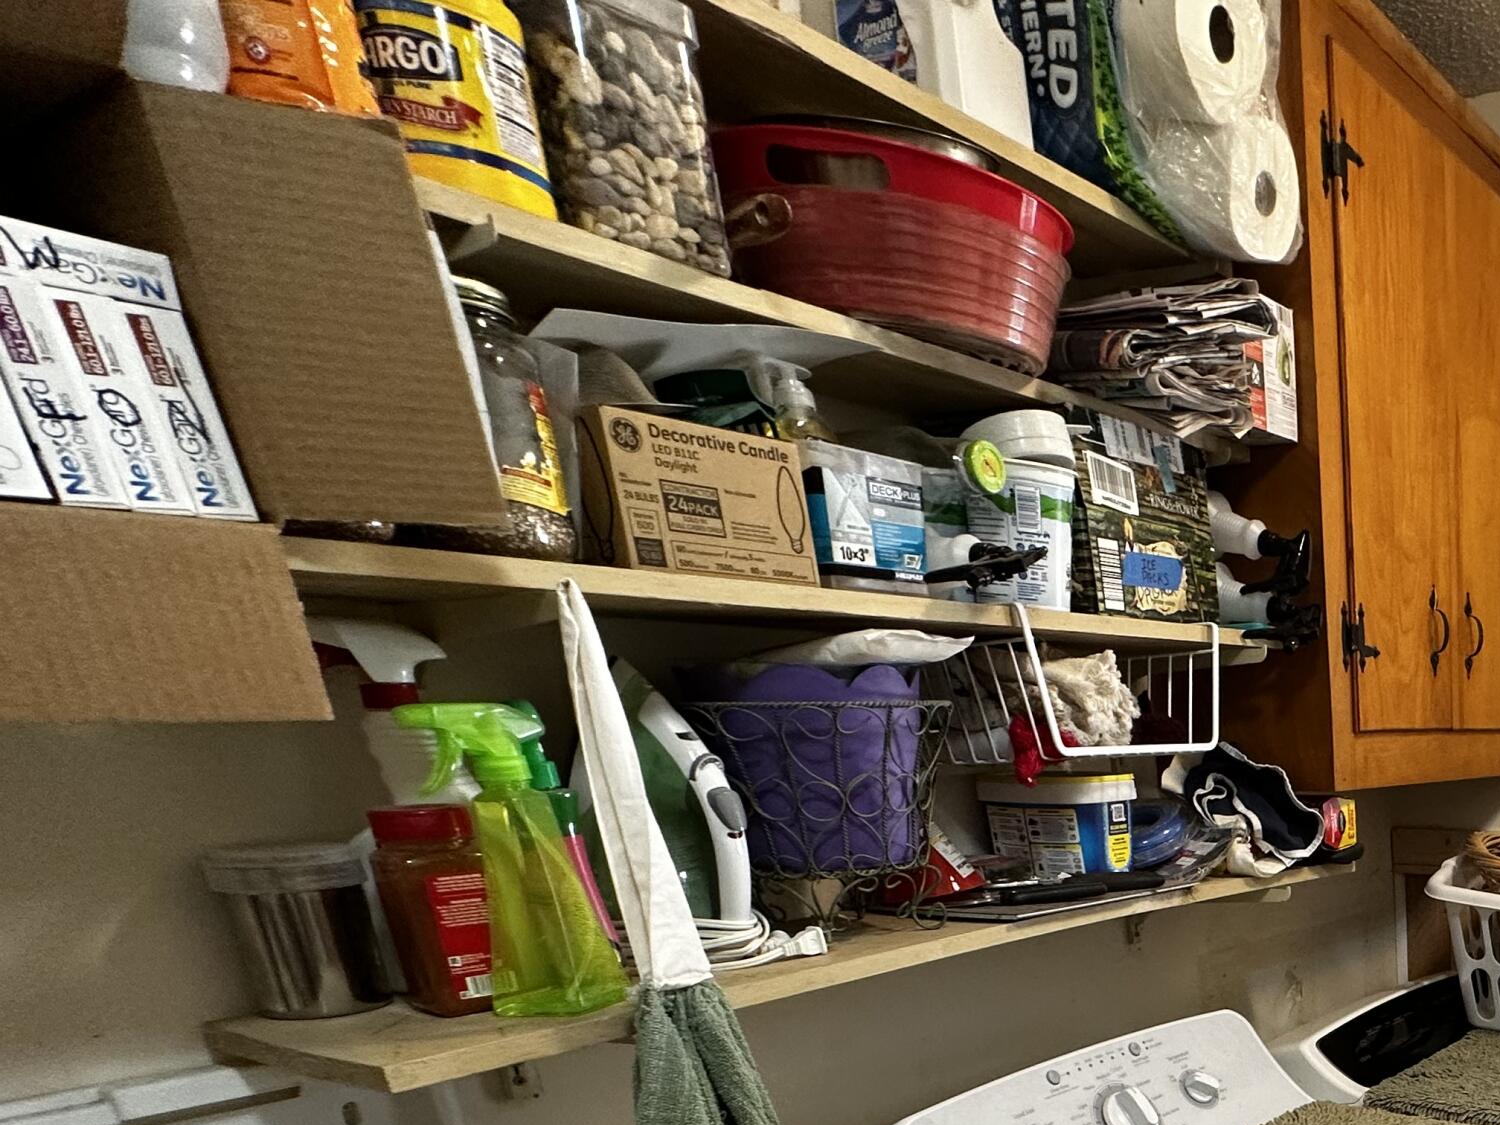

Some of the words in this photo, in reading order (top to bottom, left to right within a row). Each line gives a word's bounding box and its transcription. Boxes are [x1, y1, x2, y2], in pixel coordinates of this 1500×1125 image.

[853, 13, 898, 43] Almond
[364, 35, 447, 75] ARGO
[402, 101, 458, 124] STARCH
[647, 423, 736, 453] Decorative
[739, 441, 789, 463] Candle
[652, 443, 672, 455] LED
[654, 457, 698, 473] Daylight
[871, 484, 900, 498] DECK
